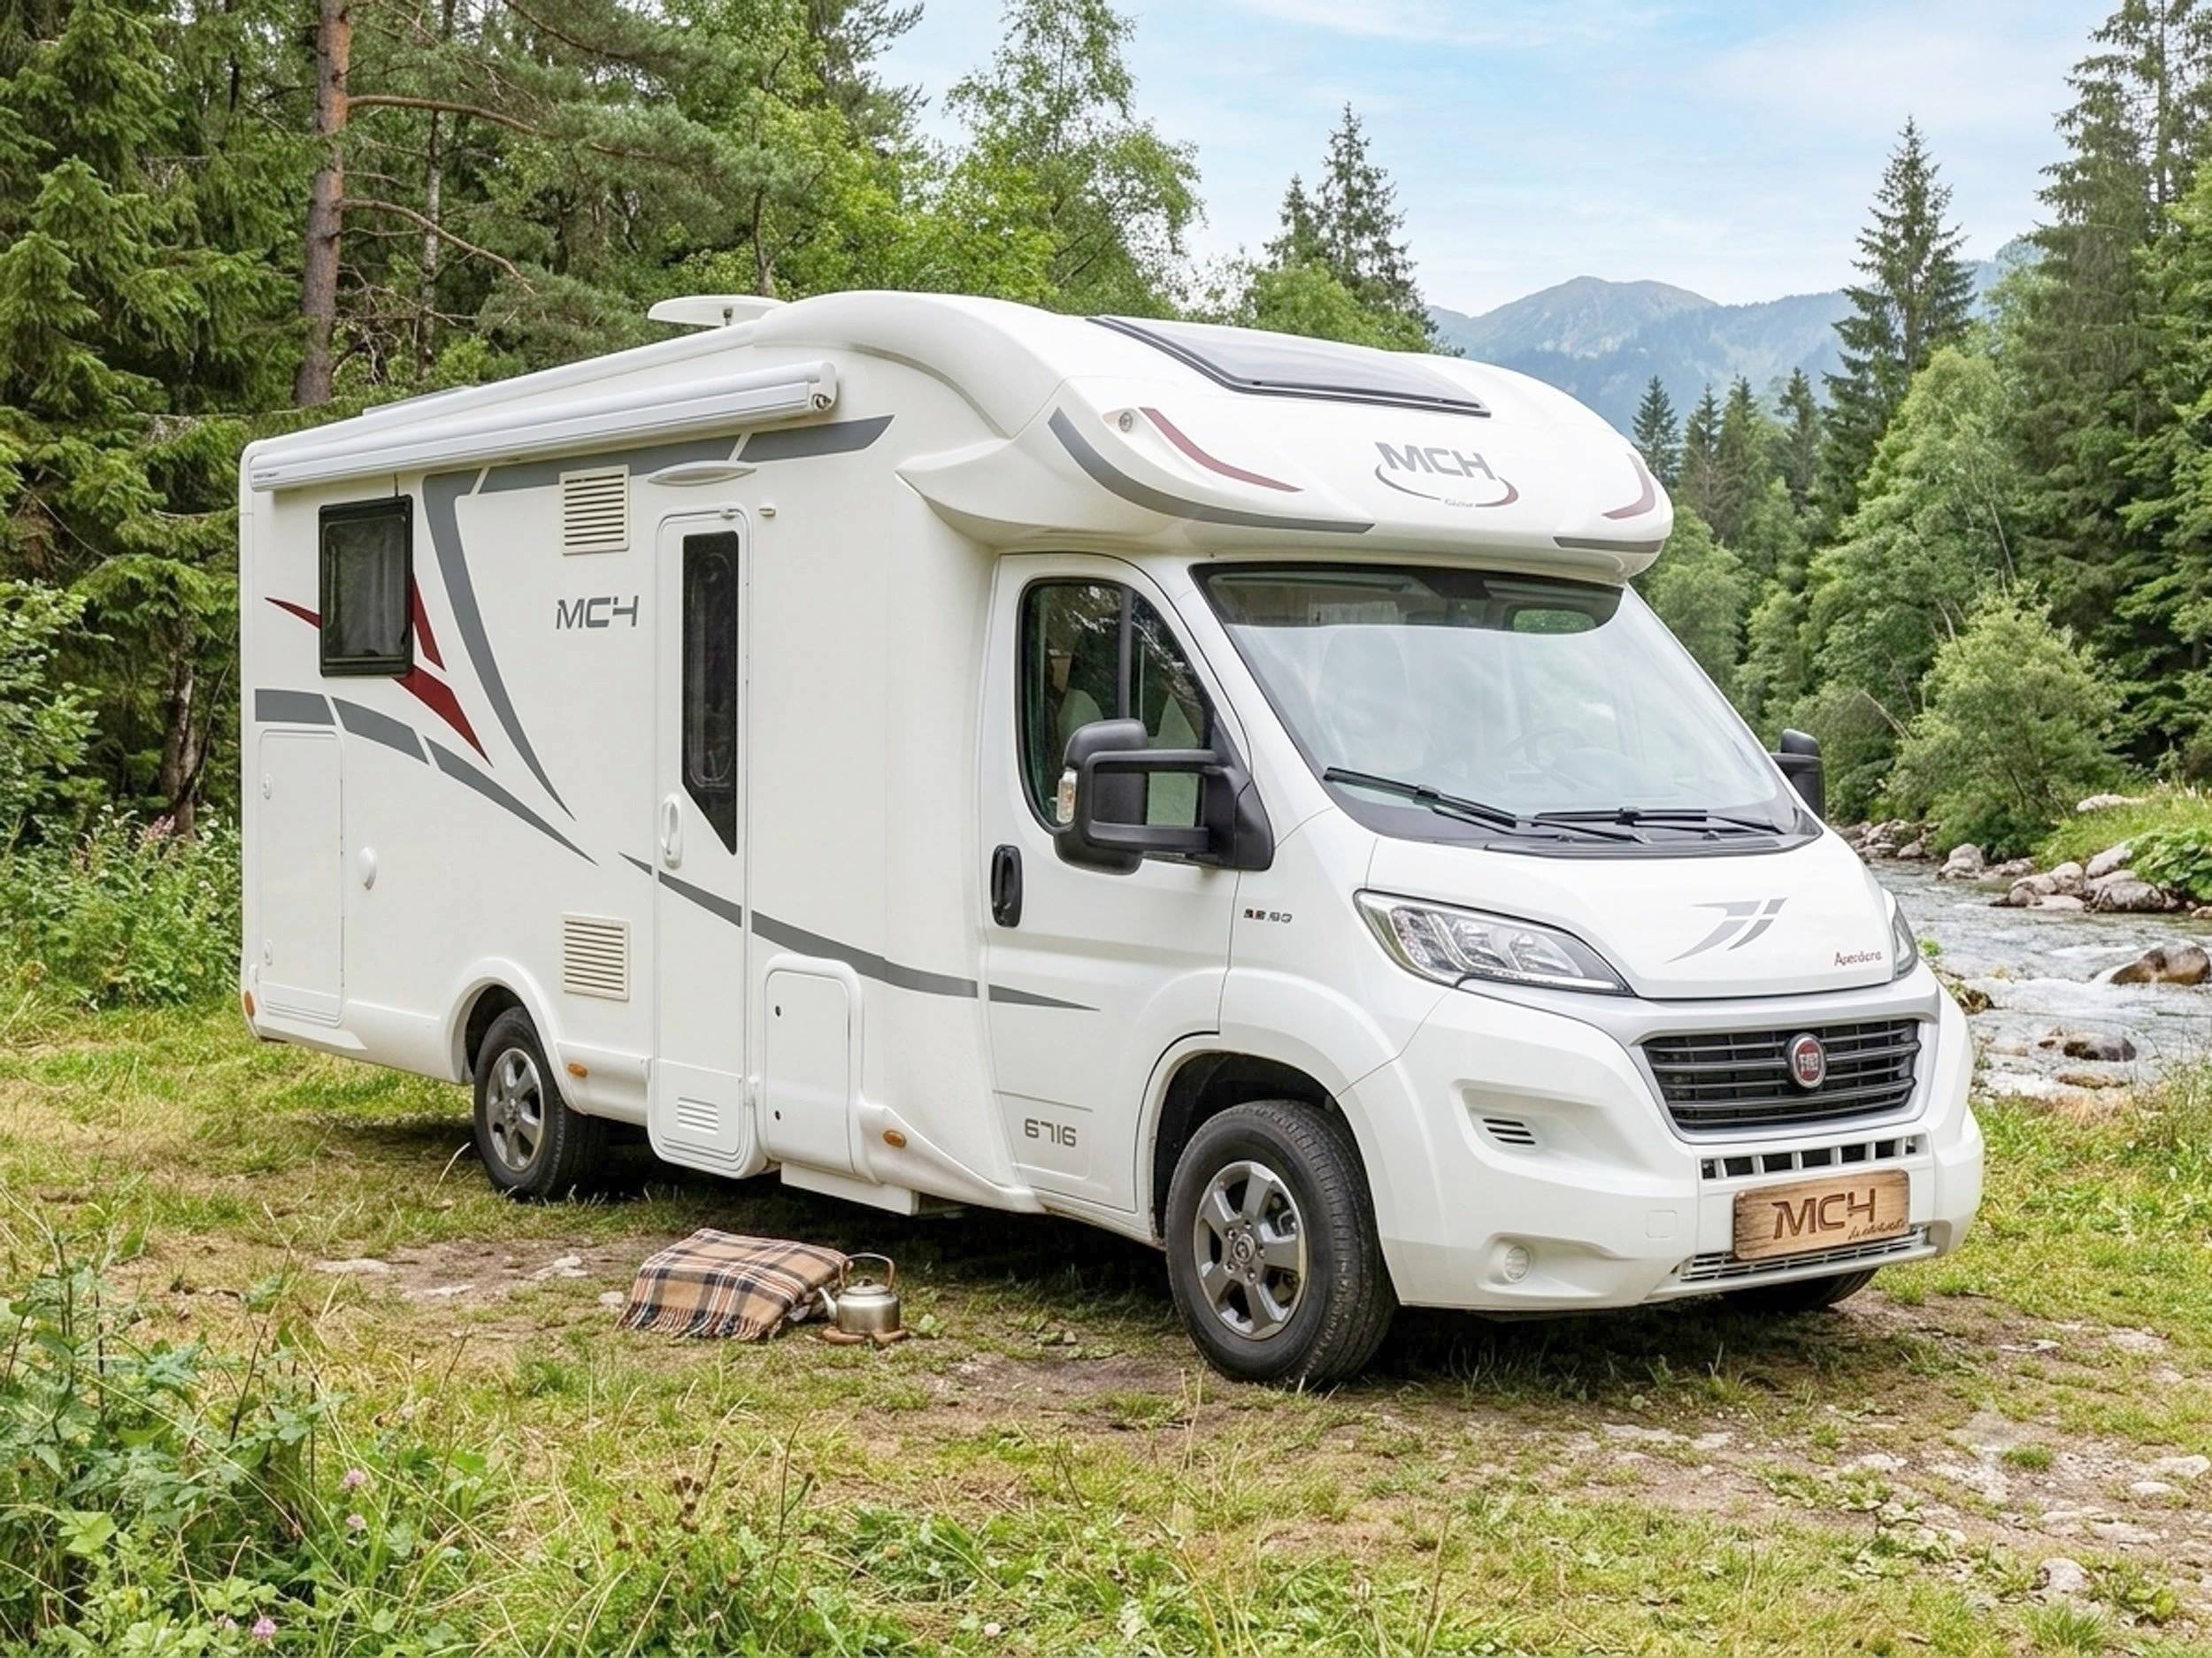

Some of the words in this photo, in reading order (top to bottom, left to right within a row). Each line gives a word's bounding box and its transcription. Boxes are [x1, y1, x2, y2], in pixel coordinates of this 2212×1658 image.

[1374, 441, 1496, 480] MCH
[556, 595, 639, 629] MCH
[1025, 1118, 1076, 1148] 6716
[1771, 1187, 1876, 1240] MCH
